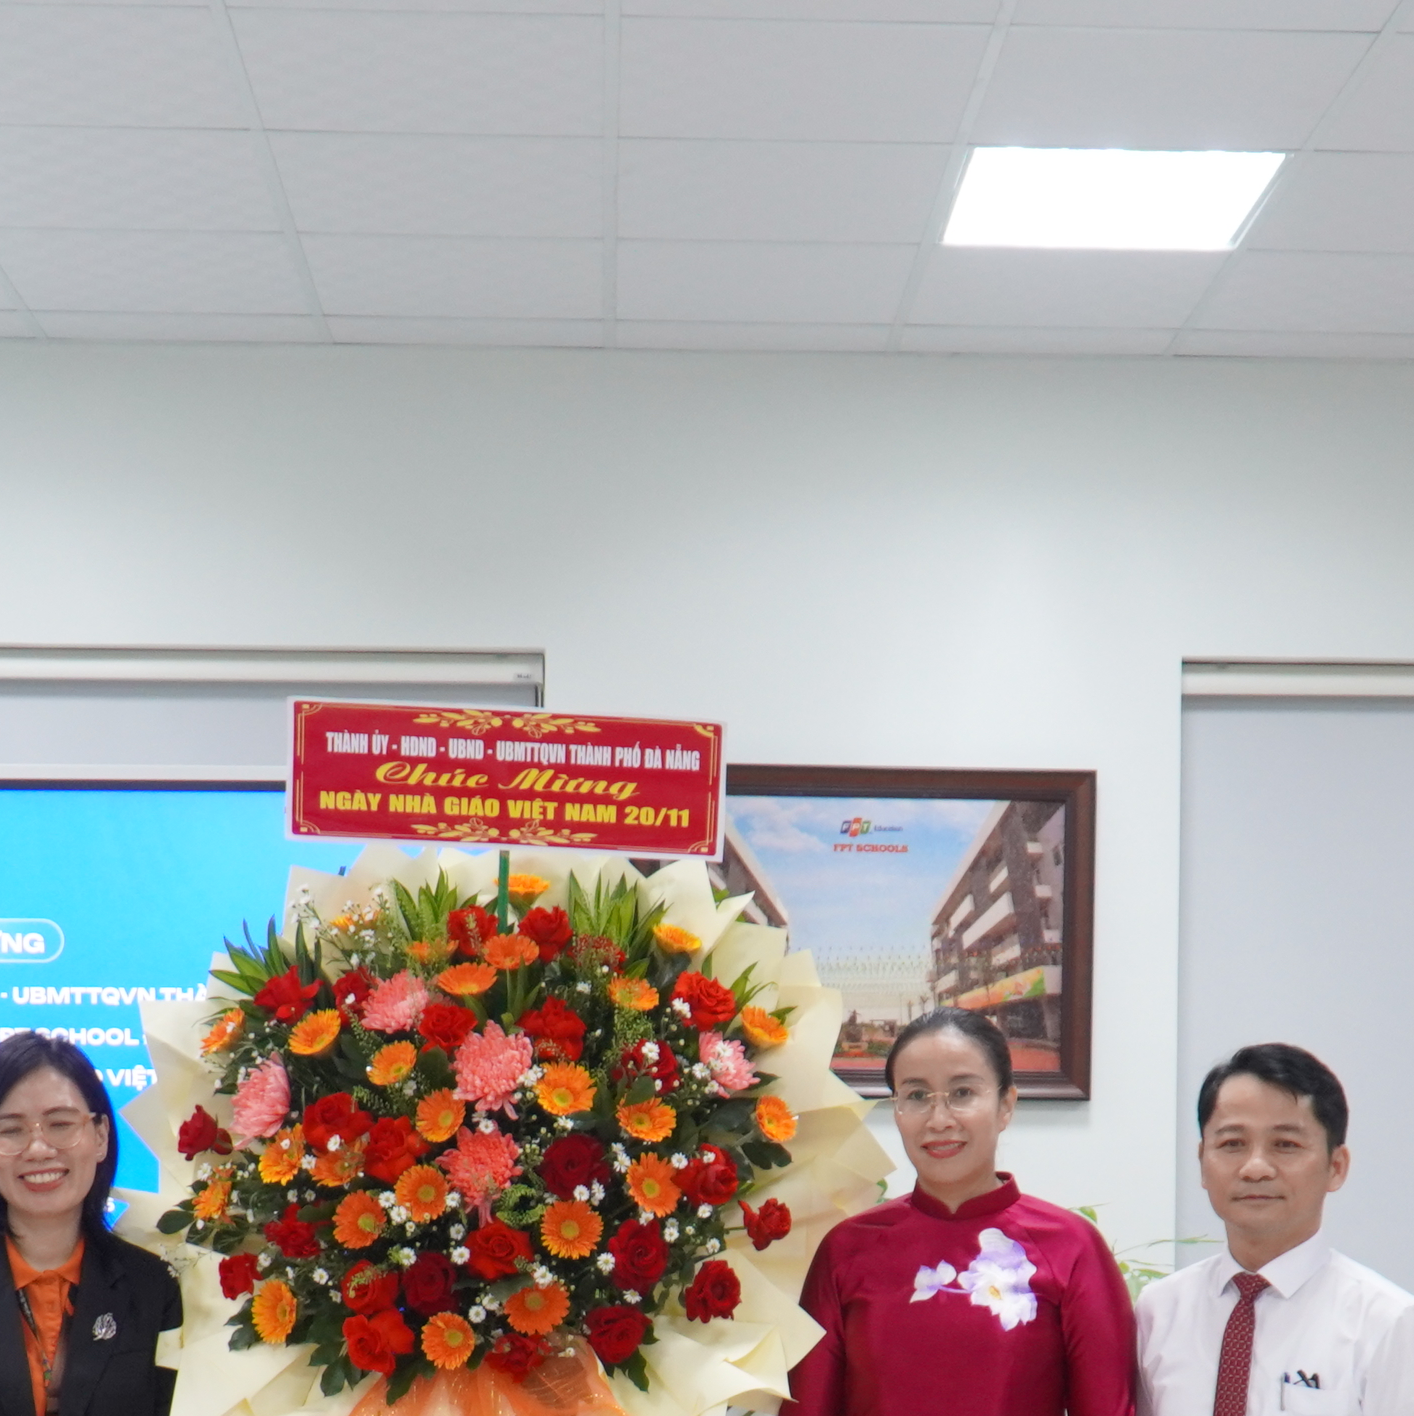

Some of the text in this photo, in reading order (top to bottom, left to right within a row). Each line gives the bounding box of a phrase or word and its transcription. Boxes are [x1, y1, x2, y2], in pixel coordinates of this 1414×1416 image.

[325, 729, 369, 755] THÀNH
[448, 738, 485, 760] UBND
[495, 740, 567, 765] UBMTTQVN
[569, 742, 612, 767] THÀNH
[614, 741, 641, 768] PHỐ
[644, 746, 662, 769] ĐÀ
[375, 760, 641, 801] Chúc Mừng
[319, 789, 690, 828] NGÀY NHÀ GIÁO VIỆT NAM 20/11
[12, 986, 156, 1006] UBMTTQVN
[159, 983, 207, 1001] THÀ
